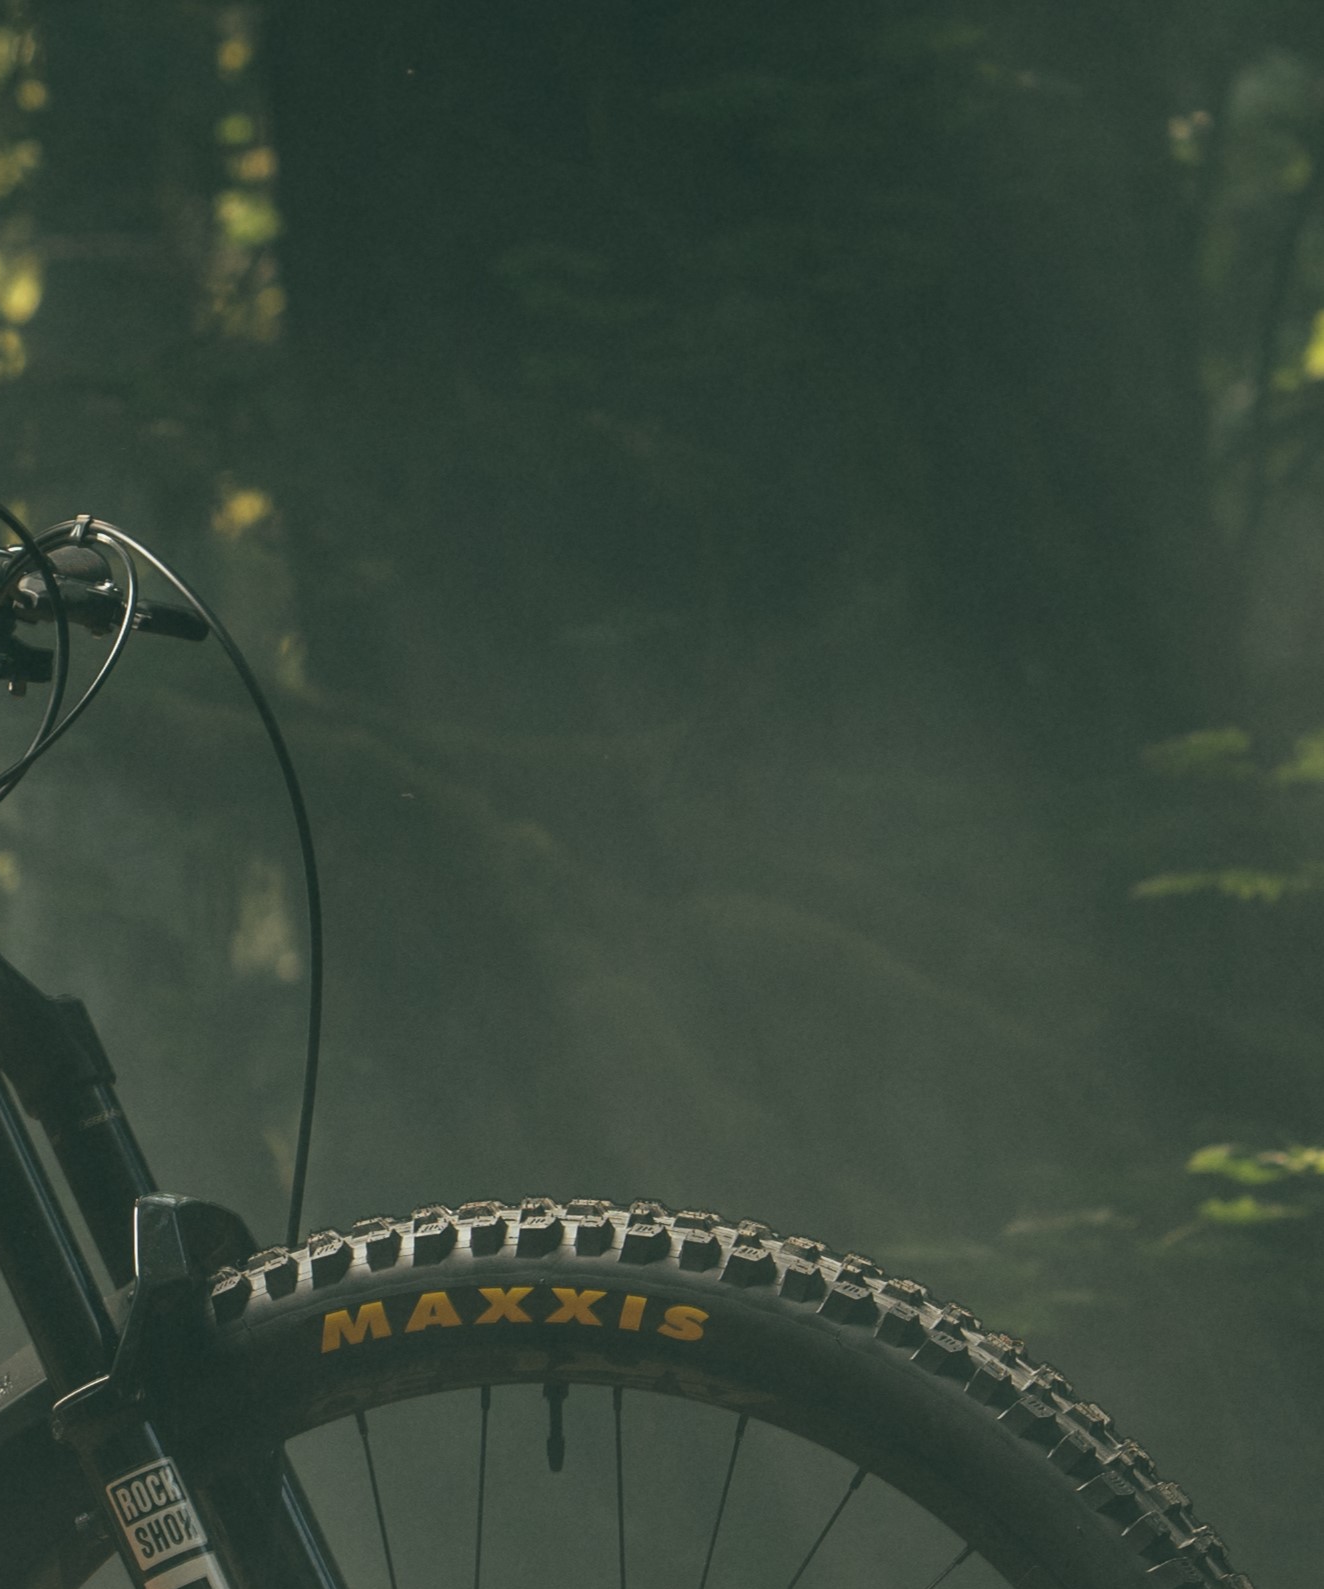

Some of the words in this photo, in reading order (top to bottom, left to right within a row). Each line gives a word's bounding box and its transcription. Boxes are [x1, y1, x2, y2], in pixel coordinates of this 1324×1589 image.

[320, 1287, 710, 1353] MAXXIS
[115, 1464, 185, 1523] ROCK
[134, 1508, 200, 1559] SHOX
